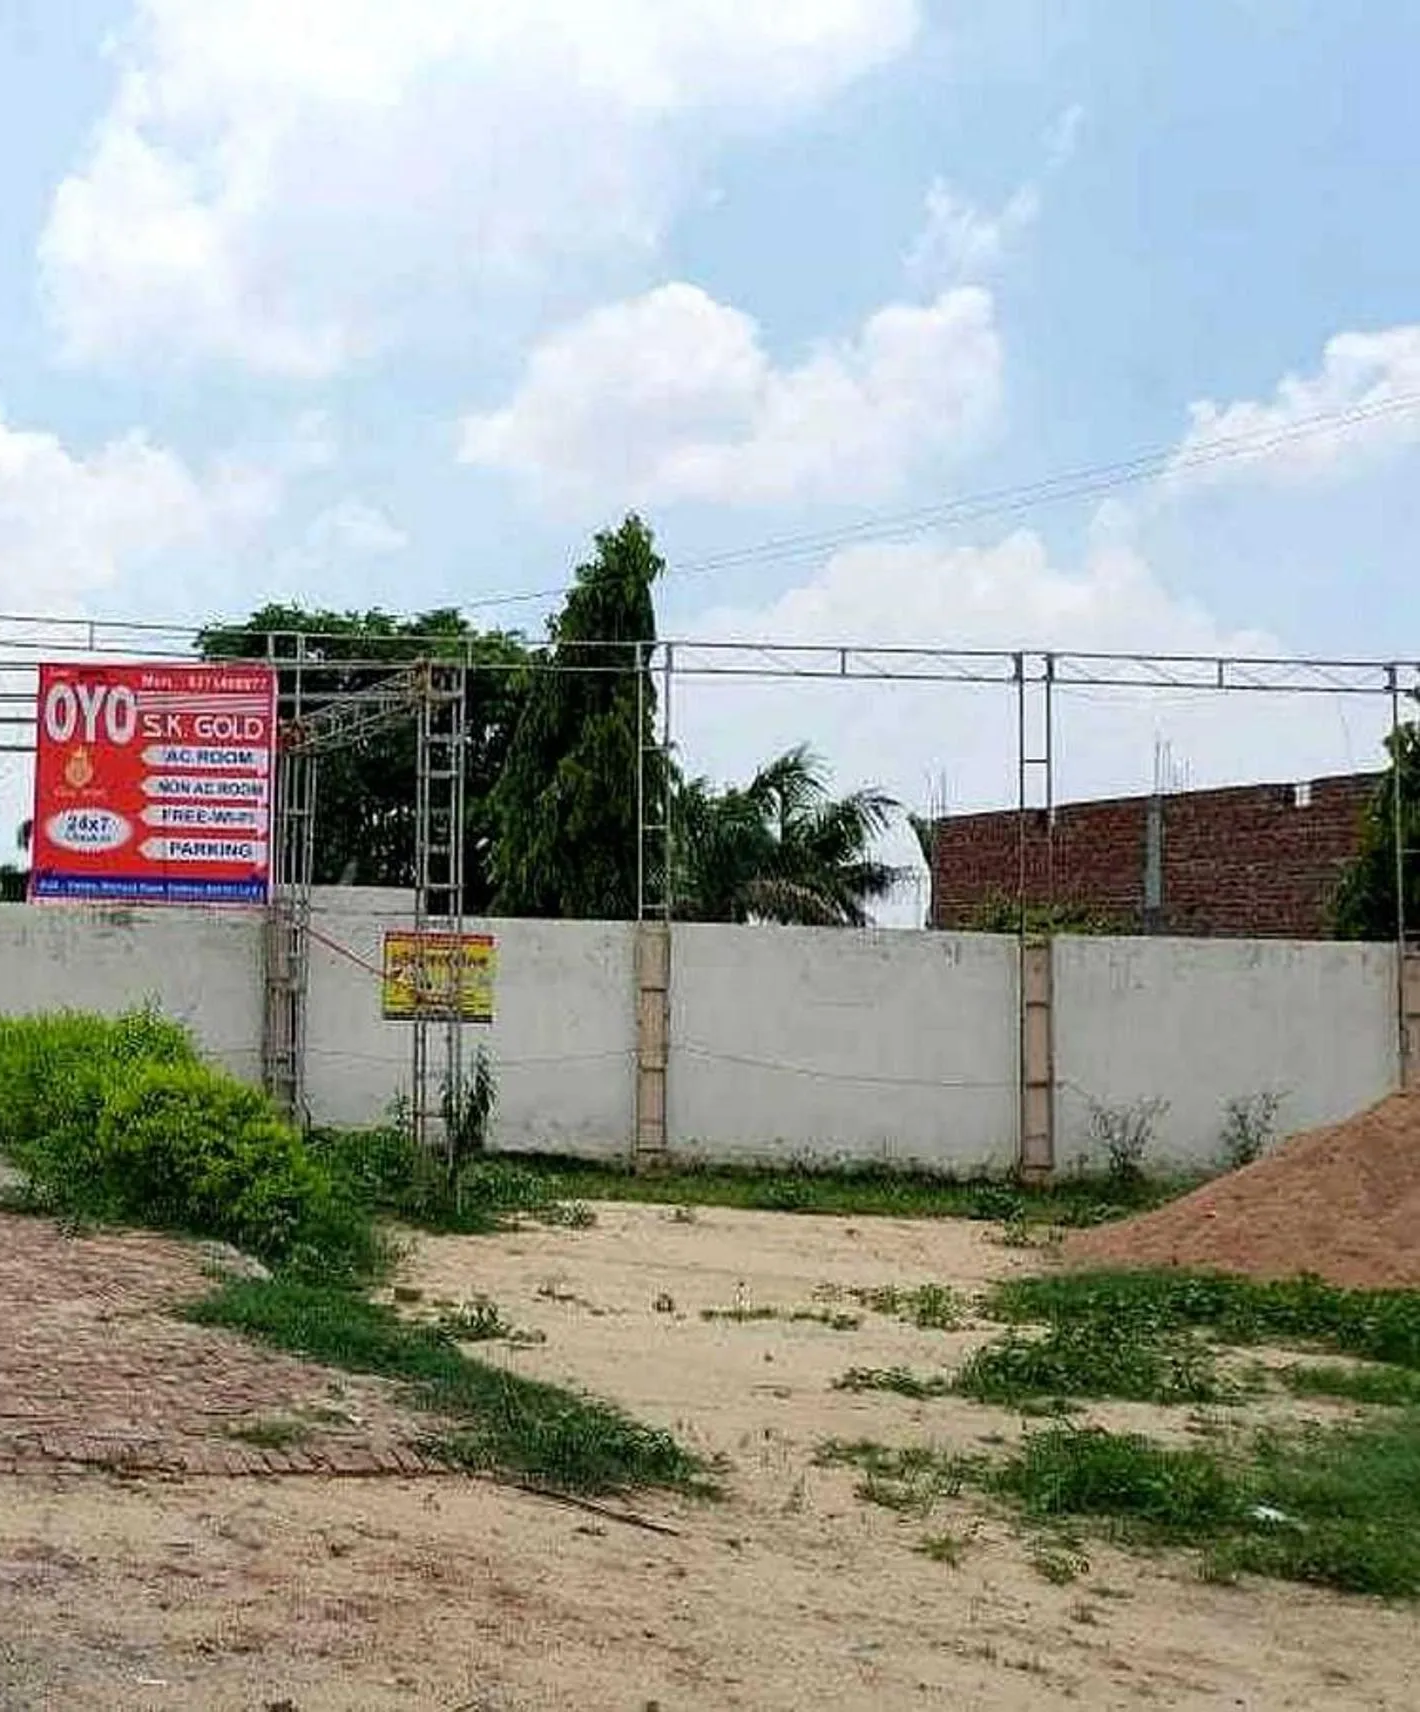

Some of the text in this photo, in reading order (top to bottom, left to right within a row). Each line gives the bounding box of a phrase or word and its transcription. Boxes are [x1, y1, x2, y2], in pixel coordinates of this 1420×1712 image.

[45, 682, 137, 745] OYO
[194, 715, 264, 740] GOLD
[196, 750, 253, 764] ROOM
[159, 779, 190, 794] NON
[217, 782, 264, 797] ROOM
[170, 842, 253, 858] PARKING
